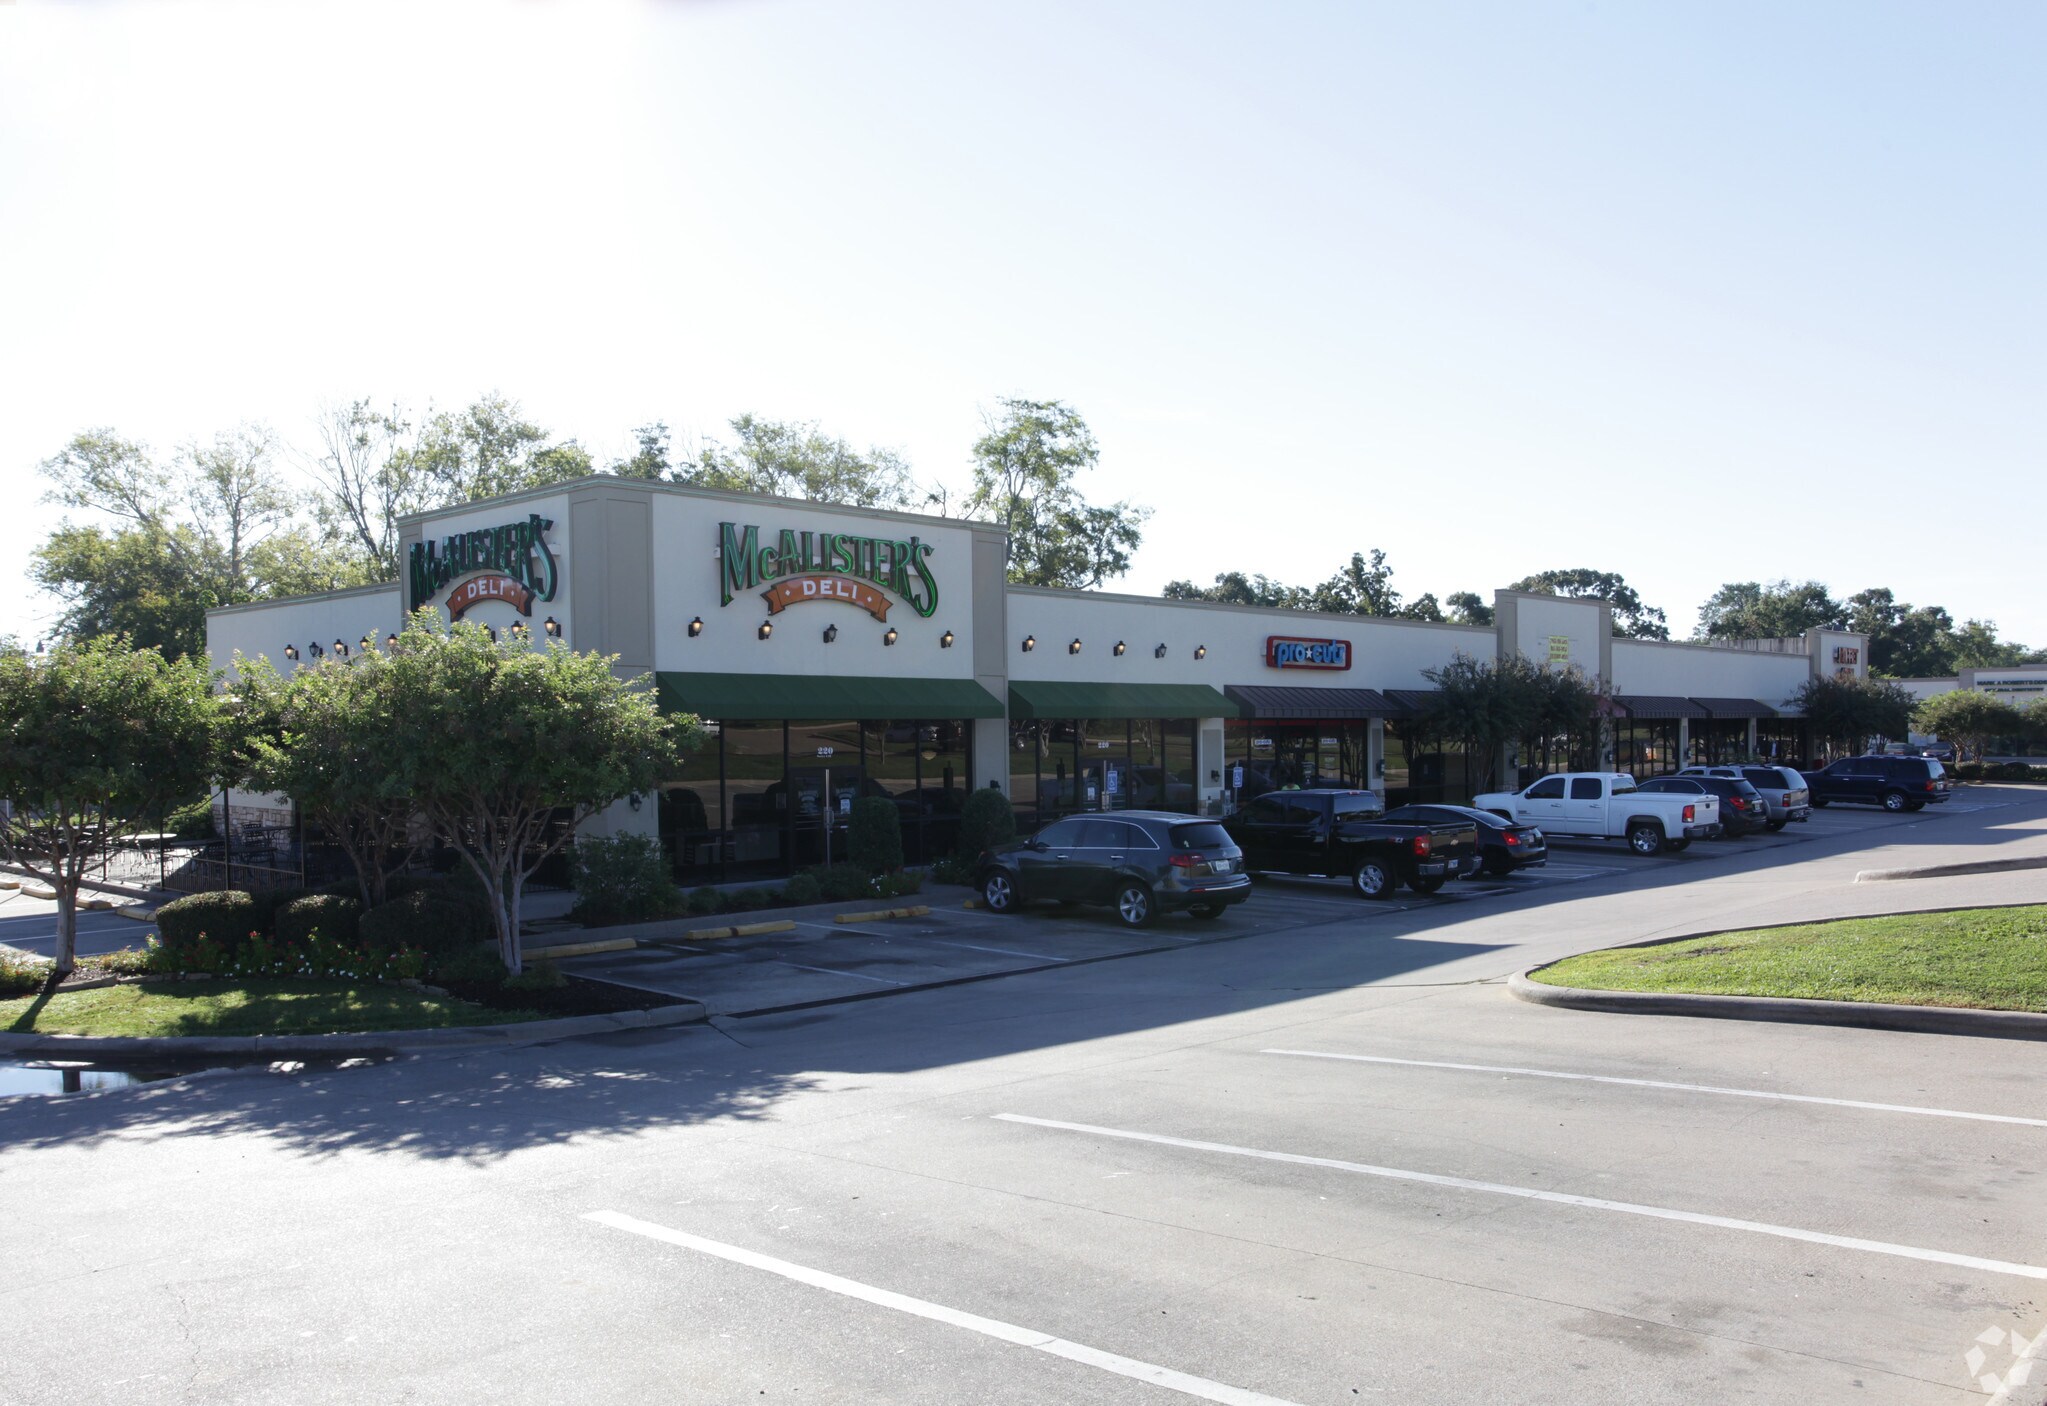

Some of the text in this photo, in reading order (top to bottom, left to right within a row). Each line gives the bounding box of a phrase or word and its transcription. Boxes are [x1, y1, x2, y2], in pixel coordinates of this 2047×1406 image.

[719, 522, 938, 617] McALISTER'S
[467, 579, 504, 599] DELI
[802, 580, 858, 600] DELI
[817, 747, 834, 755] 220
